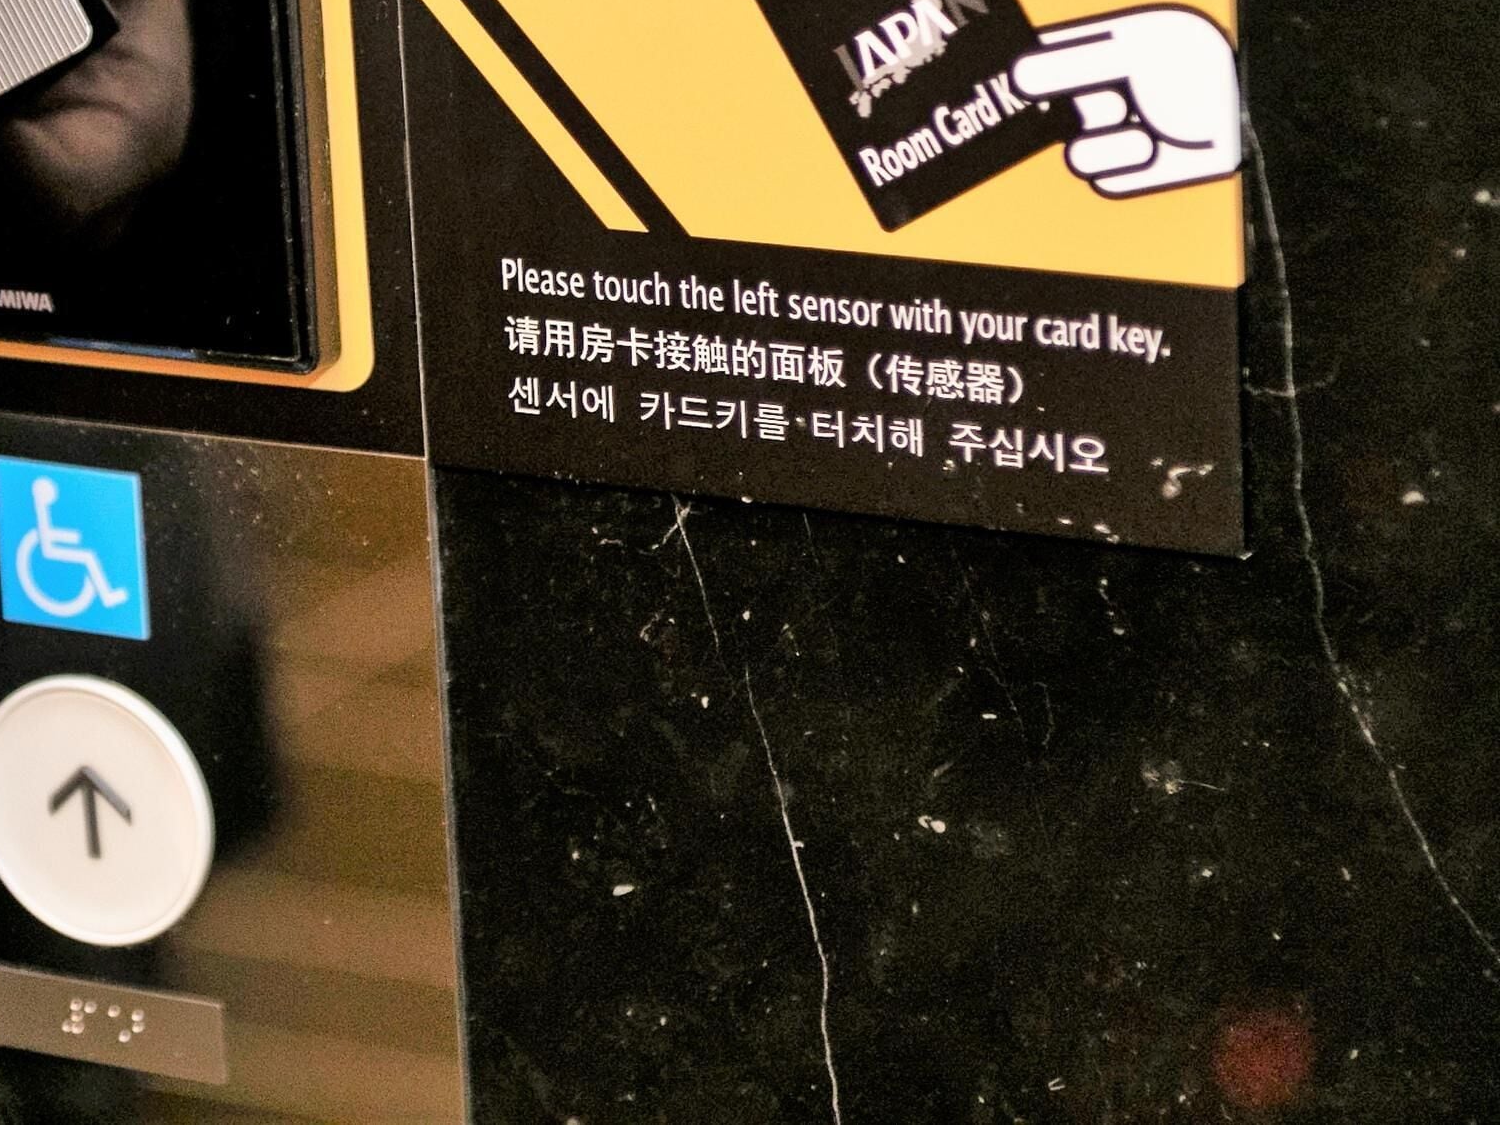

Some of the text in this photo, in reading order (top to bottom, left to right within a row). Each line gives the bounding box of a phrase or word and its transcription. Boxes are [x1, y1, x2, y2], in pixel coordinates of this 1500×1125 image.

[858, 127, 944, 187] Room
[933, 83, 1002, 146] Card
[501, 257, 1172, 364] Please touch the left sensor with your card key.
[507, 376, 1110, 474] 센서에 카드키를 터치해 주십시오
